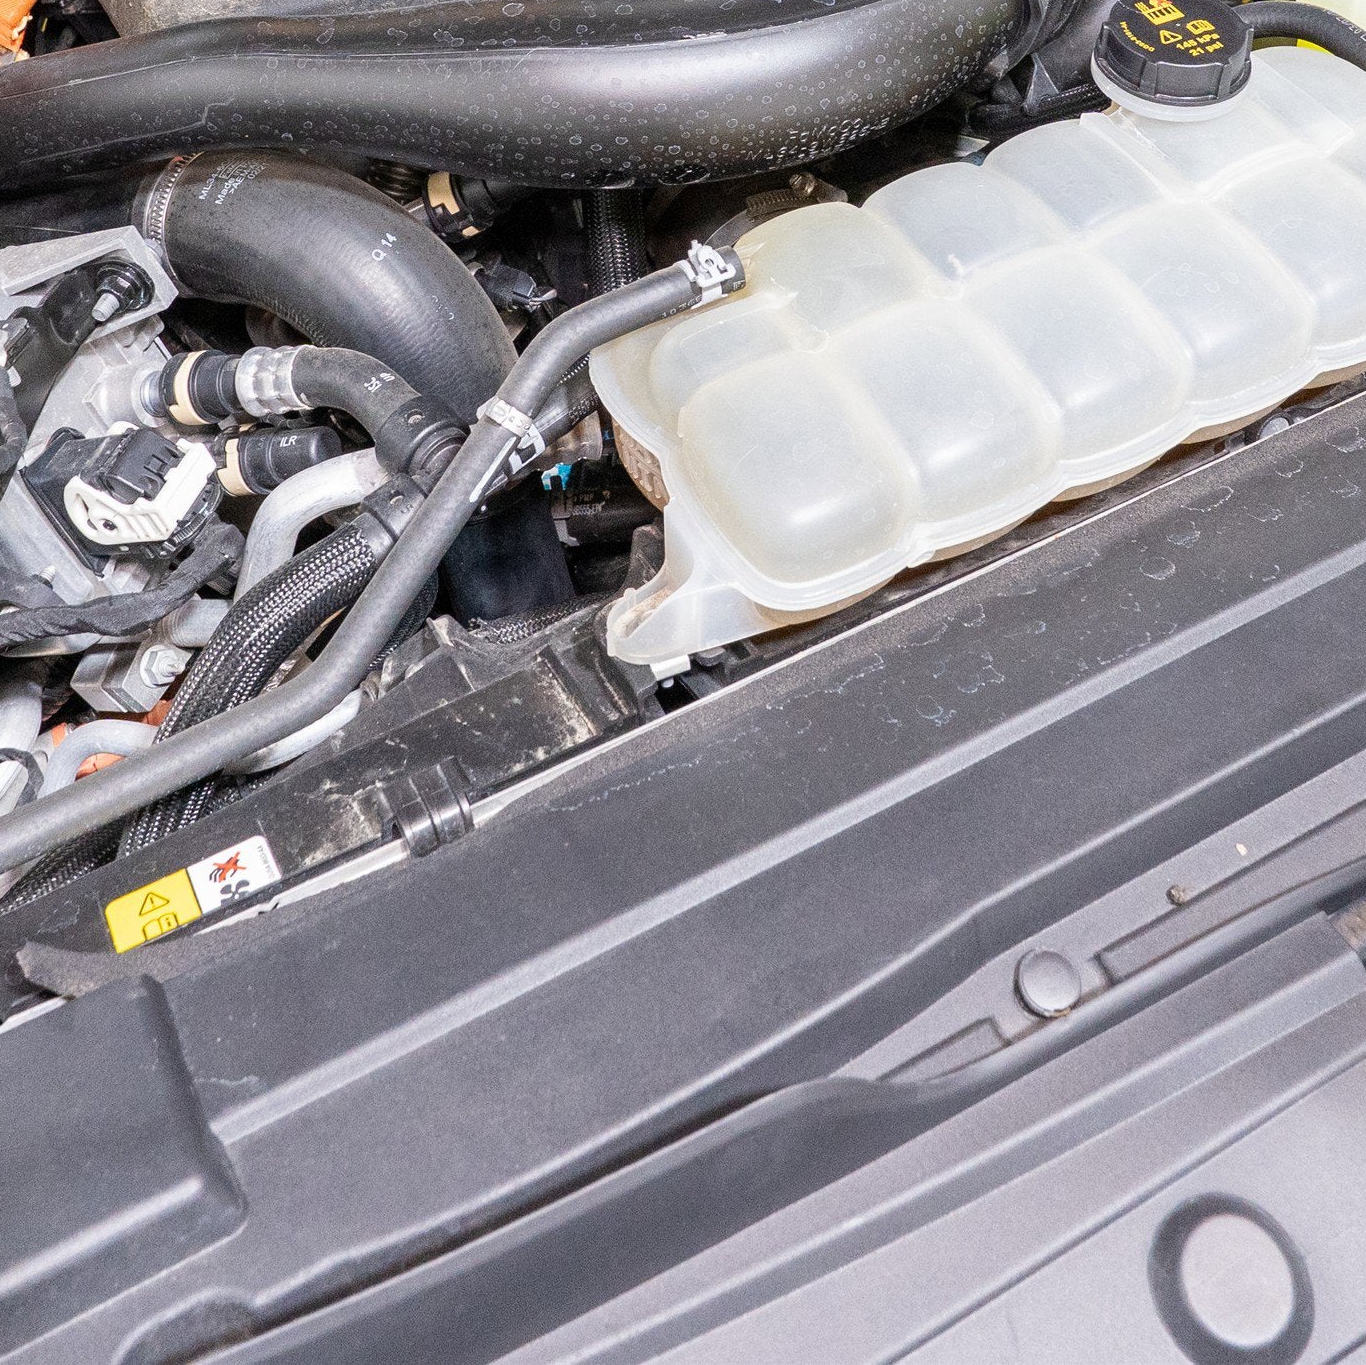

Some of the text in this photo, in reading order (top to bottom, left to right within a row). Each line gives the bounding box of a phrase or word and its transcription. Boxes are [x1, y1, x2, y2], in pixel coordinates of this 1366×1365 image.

[1175, 32, 1220, 49] 145 kPa
[1188, 40, 1224, 56] 21 psi
[214, 176, 236, 204] Made
[369, 230, 398, 263] Q 14
